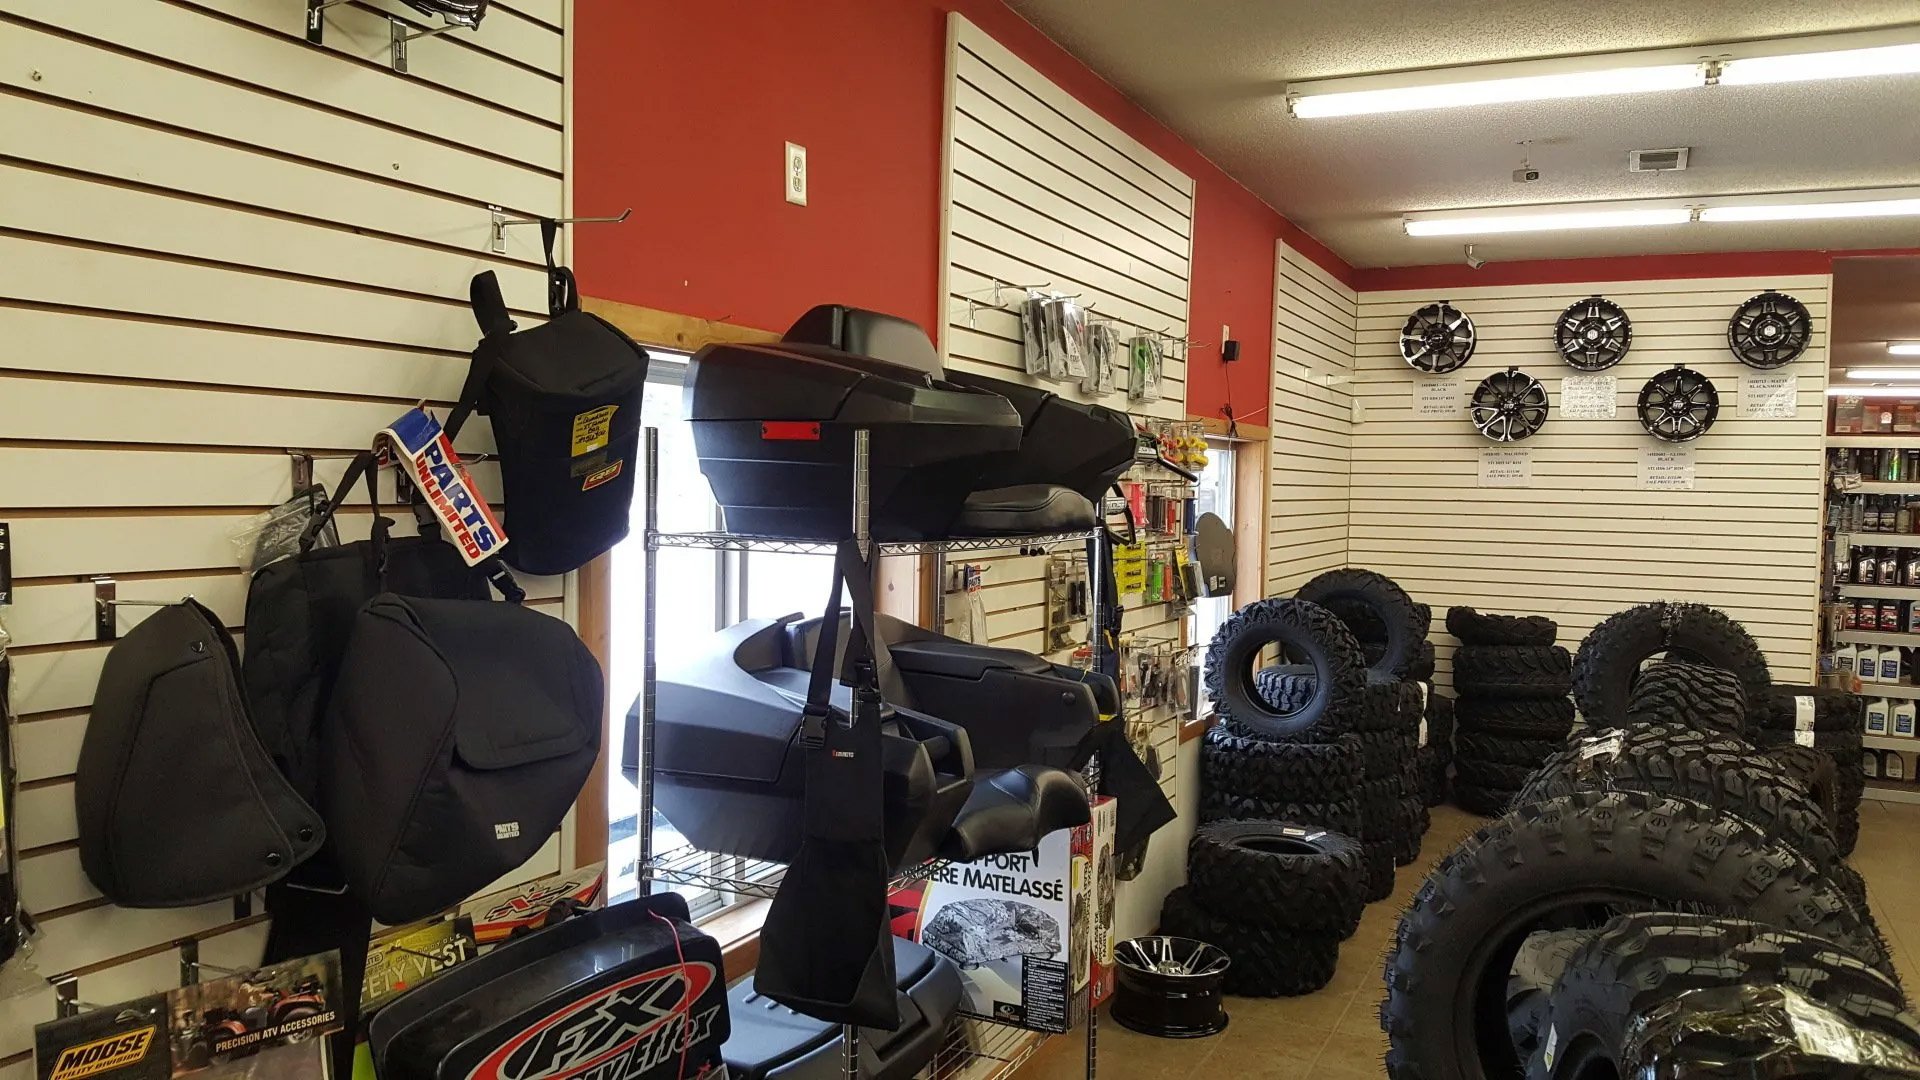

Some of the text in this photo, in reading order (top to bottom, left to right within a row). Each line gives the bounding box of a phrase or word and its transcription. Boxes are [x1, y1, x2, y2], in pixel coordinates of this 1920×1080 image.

[415, 452, 481, 560] UNLIMITED
[425, 440, 497, 552] PARTS
[494, 822, 519, 834] PARTS
[962, 867, 1064, 902] MATELASSÉ
[412, 937, 467, 978] VEST
[58, 1031, 149, 1073] MOOSE
[215, 1010, 336, 1053] PRECISION ATV ACCESSORIES
[54, 1052, 141, 1080] UTILITY DIVISION
